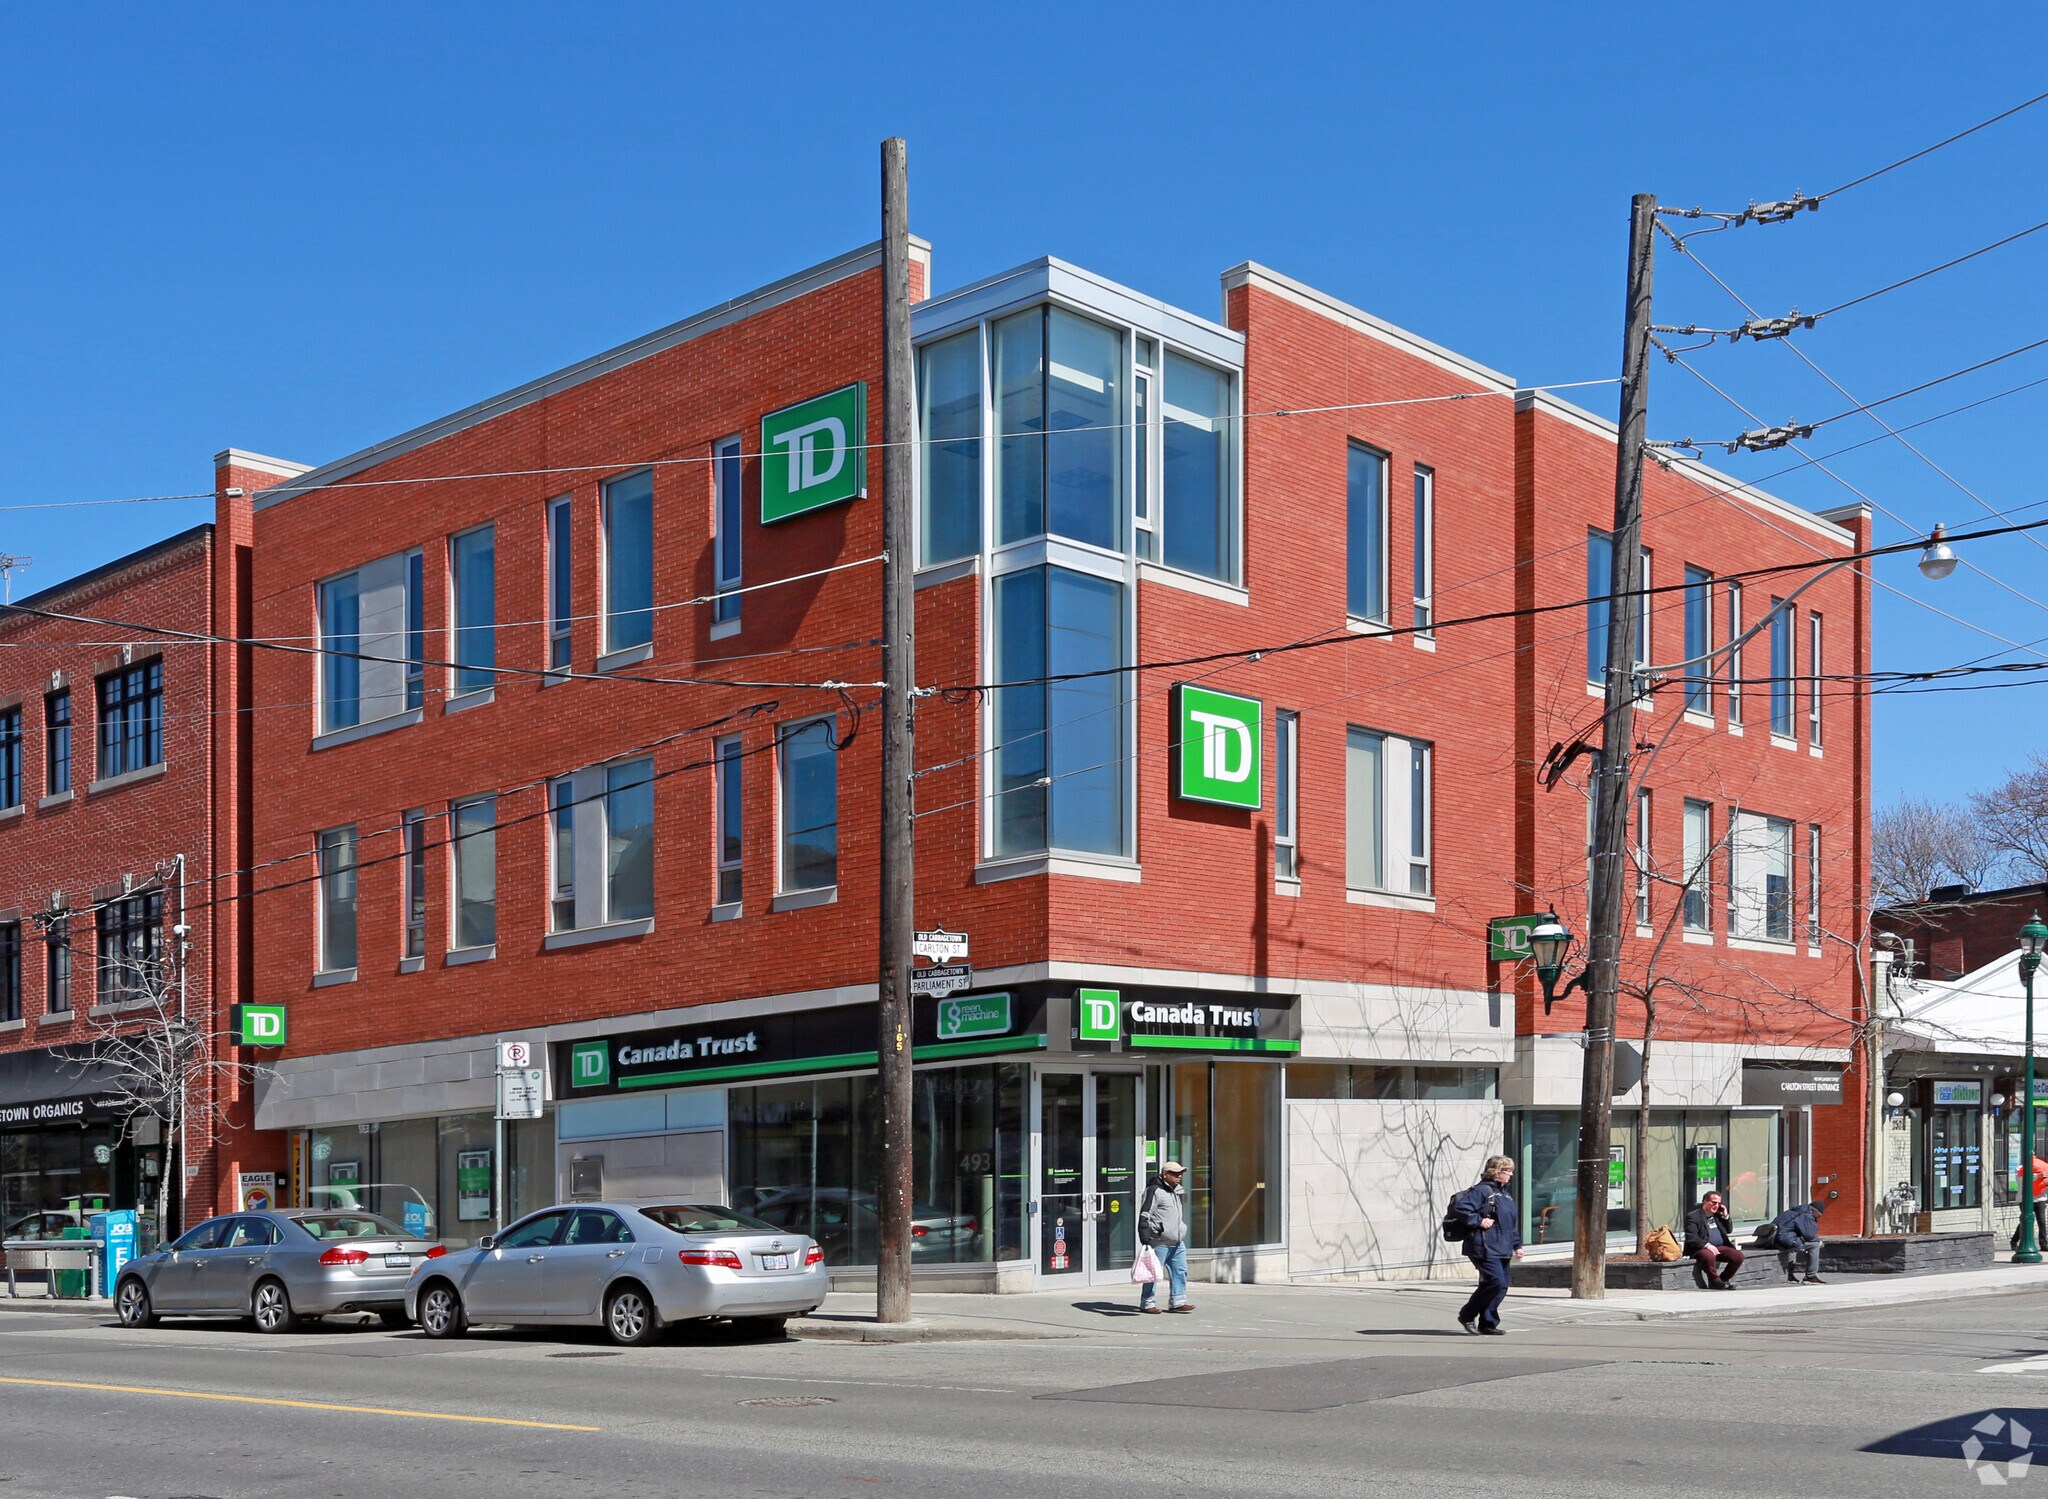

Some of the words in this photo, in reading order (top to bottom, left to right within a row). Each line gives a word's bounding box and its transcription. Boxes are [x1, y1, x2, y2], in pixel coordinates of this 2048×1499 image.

[773, 416, 846, 494] TD
[1190, 710, 1252, 783] TD
[928, 934, 963, 942] CABBAGETOWN
[1500, 925, 1532, 951] TD
[919, 943, 949, 953] CARLTON
[917, 970, 926, 978] OLD
[928, 967, 964, 977] CABBAGETOWN
[913, 979, 955, 993] PARLIAMENT
[961, 1010, 999, 1022] machine
[1085, 999, 1115, 1030] TD
[1131, 1001, 1205, 1025] Canada
[1209, 1005, 1261, 1027] Trust
[246, 1012, 280, 1036] TD
[576, 1051, 603, 1078] TD
[618, 1039, 694, 1066] Canada
[697, 1031, 757, 1057] Trust
[1802, 1083, 1816, 1091] STREET
[1817, 1083, 1840, 1092] ENTRANCE
[33, 1101, 84, 1119] ORGANICS
[960, 1153, 991, 1172] 493
[242, 1174, 272, 1183] EAGLE
[110, 1223, 133, 1233] JOB
